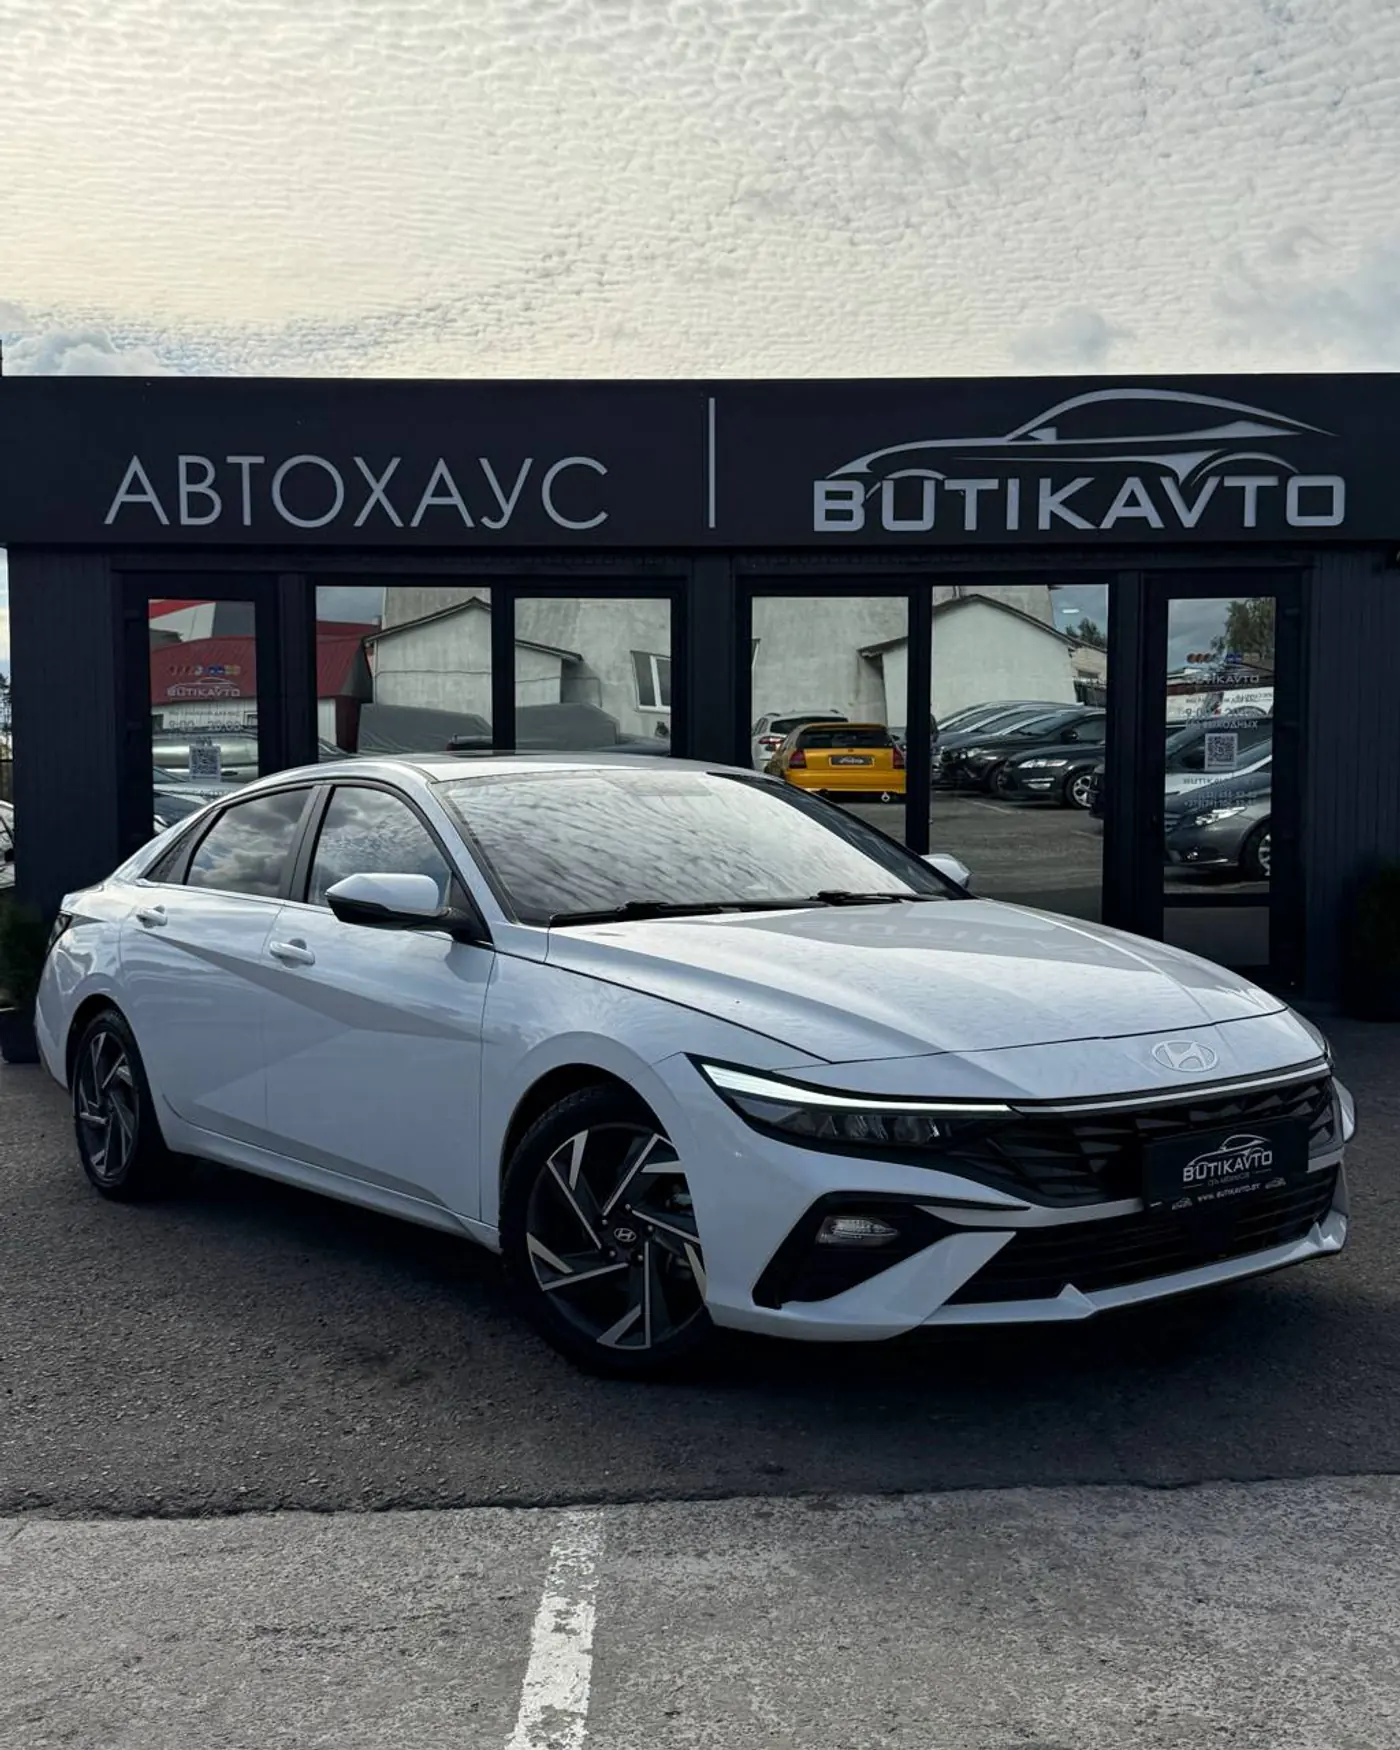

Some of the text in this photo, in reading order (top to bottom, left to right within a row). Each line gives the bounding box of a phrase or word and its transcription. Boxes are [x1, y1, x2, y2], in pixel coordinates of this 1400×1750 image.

[104, 454, 609, 530] АВТОХАУС
[813, 474, 1347, 532] BUTIKAVTO
[167, 687, 240, 697] BUTIKAVTO
[1183, 1151, 1272, 1182] BUTIKAVTO
